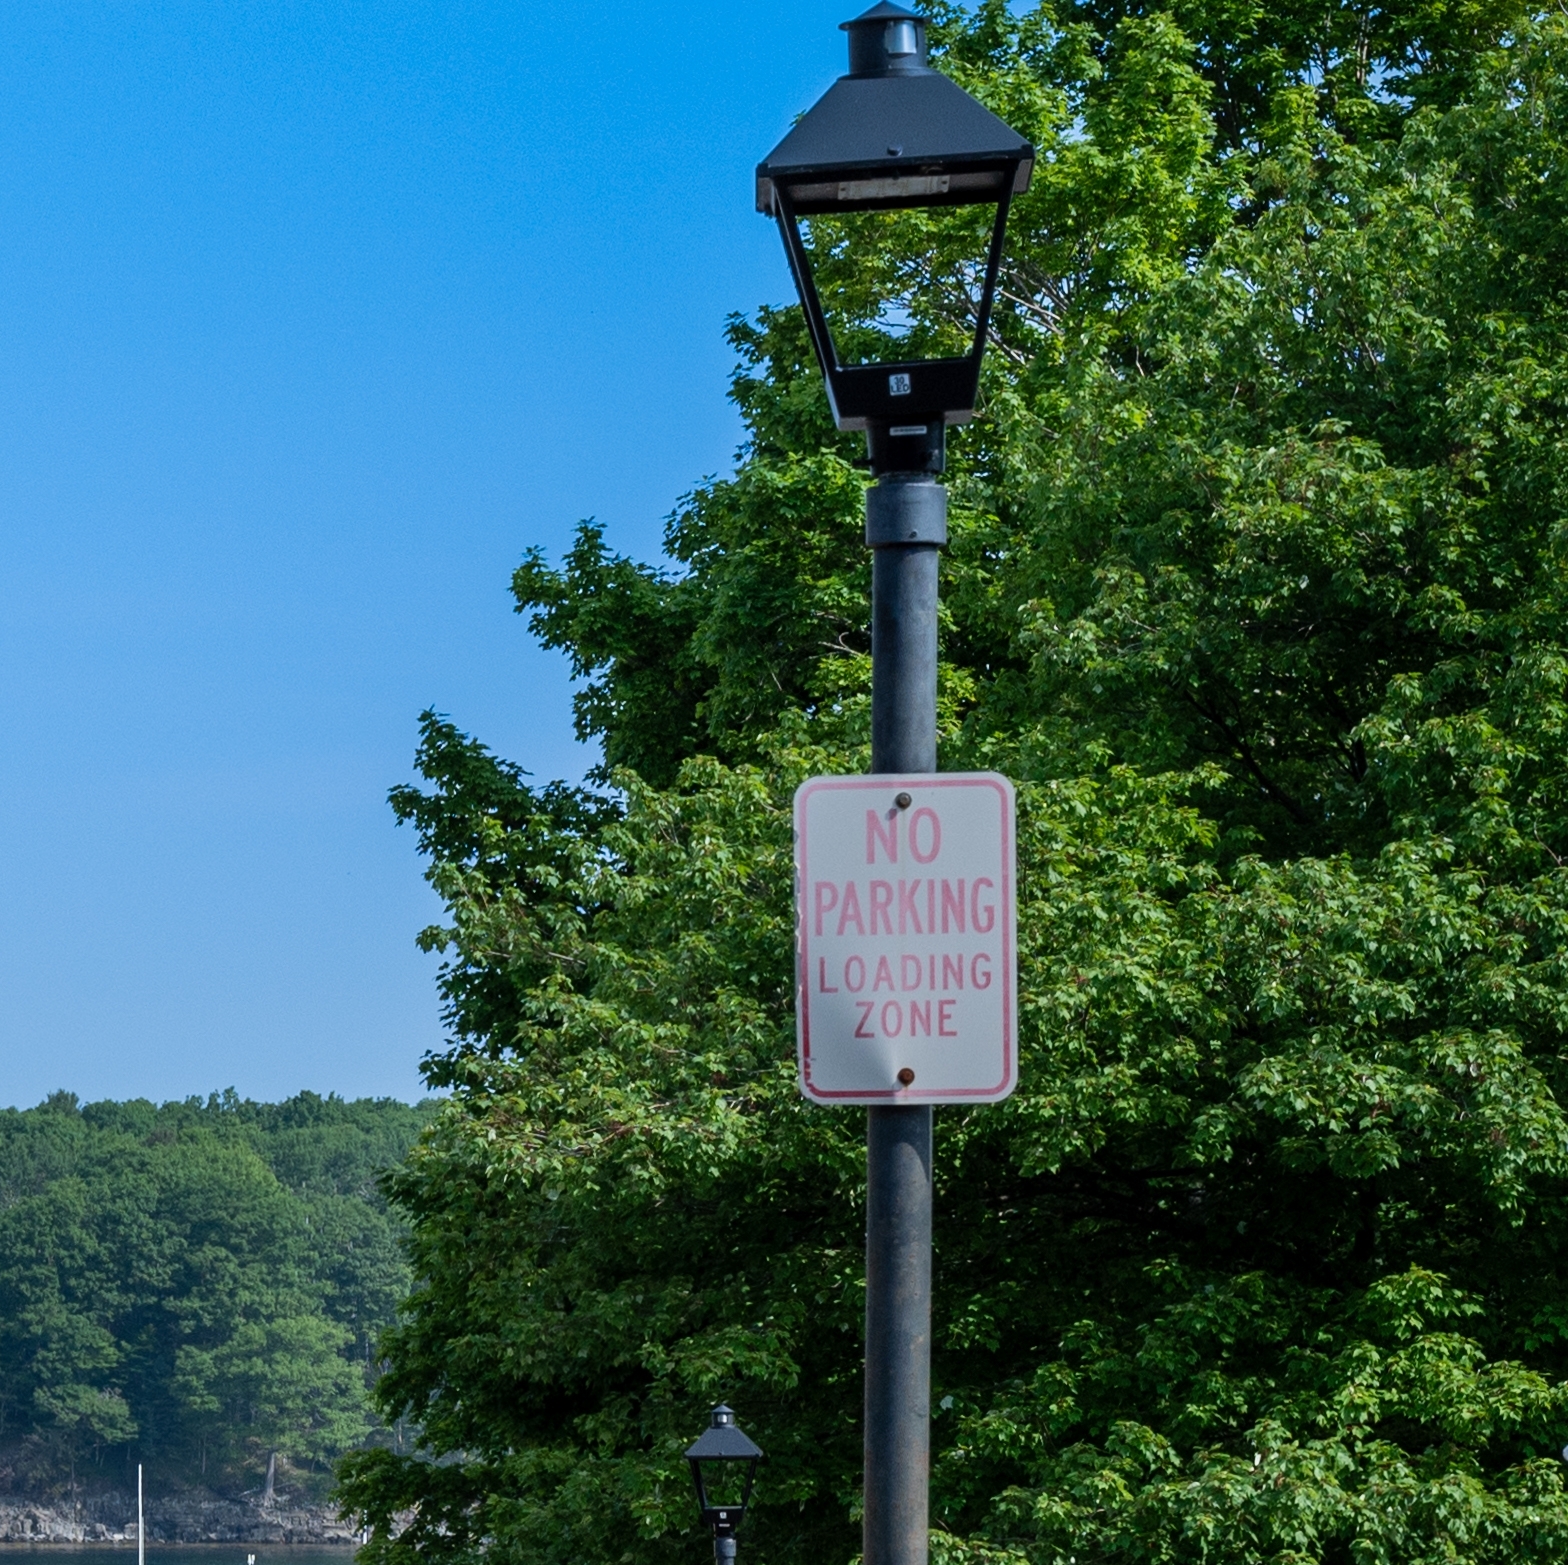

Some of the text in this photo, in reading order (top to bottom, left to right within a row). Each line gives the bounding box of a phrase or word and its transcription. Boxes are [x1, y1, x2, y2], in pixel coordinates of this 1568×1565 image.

[866, 807, 941, 865] NO
[815, 877, 995, 936] PARKING
[819, 953, 992, 993] LOADING
[854, 999, 959, 1038] ZONE
